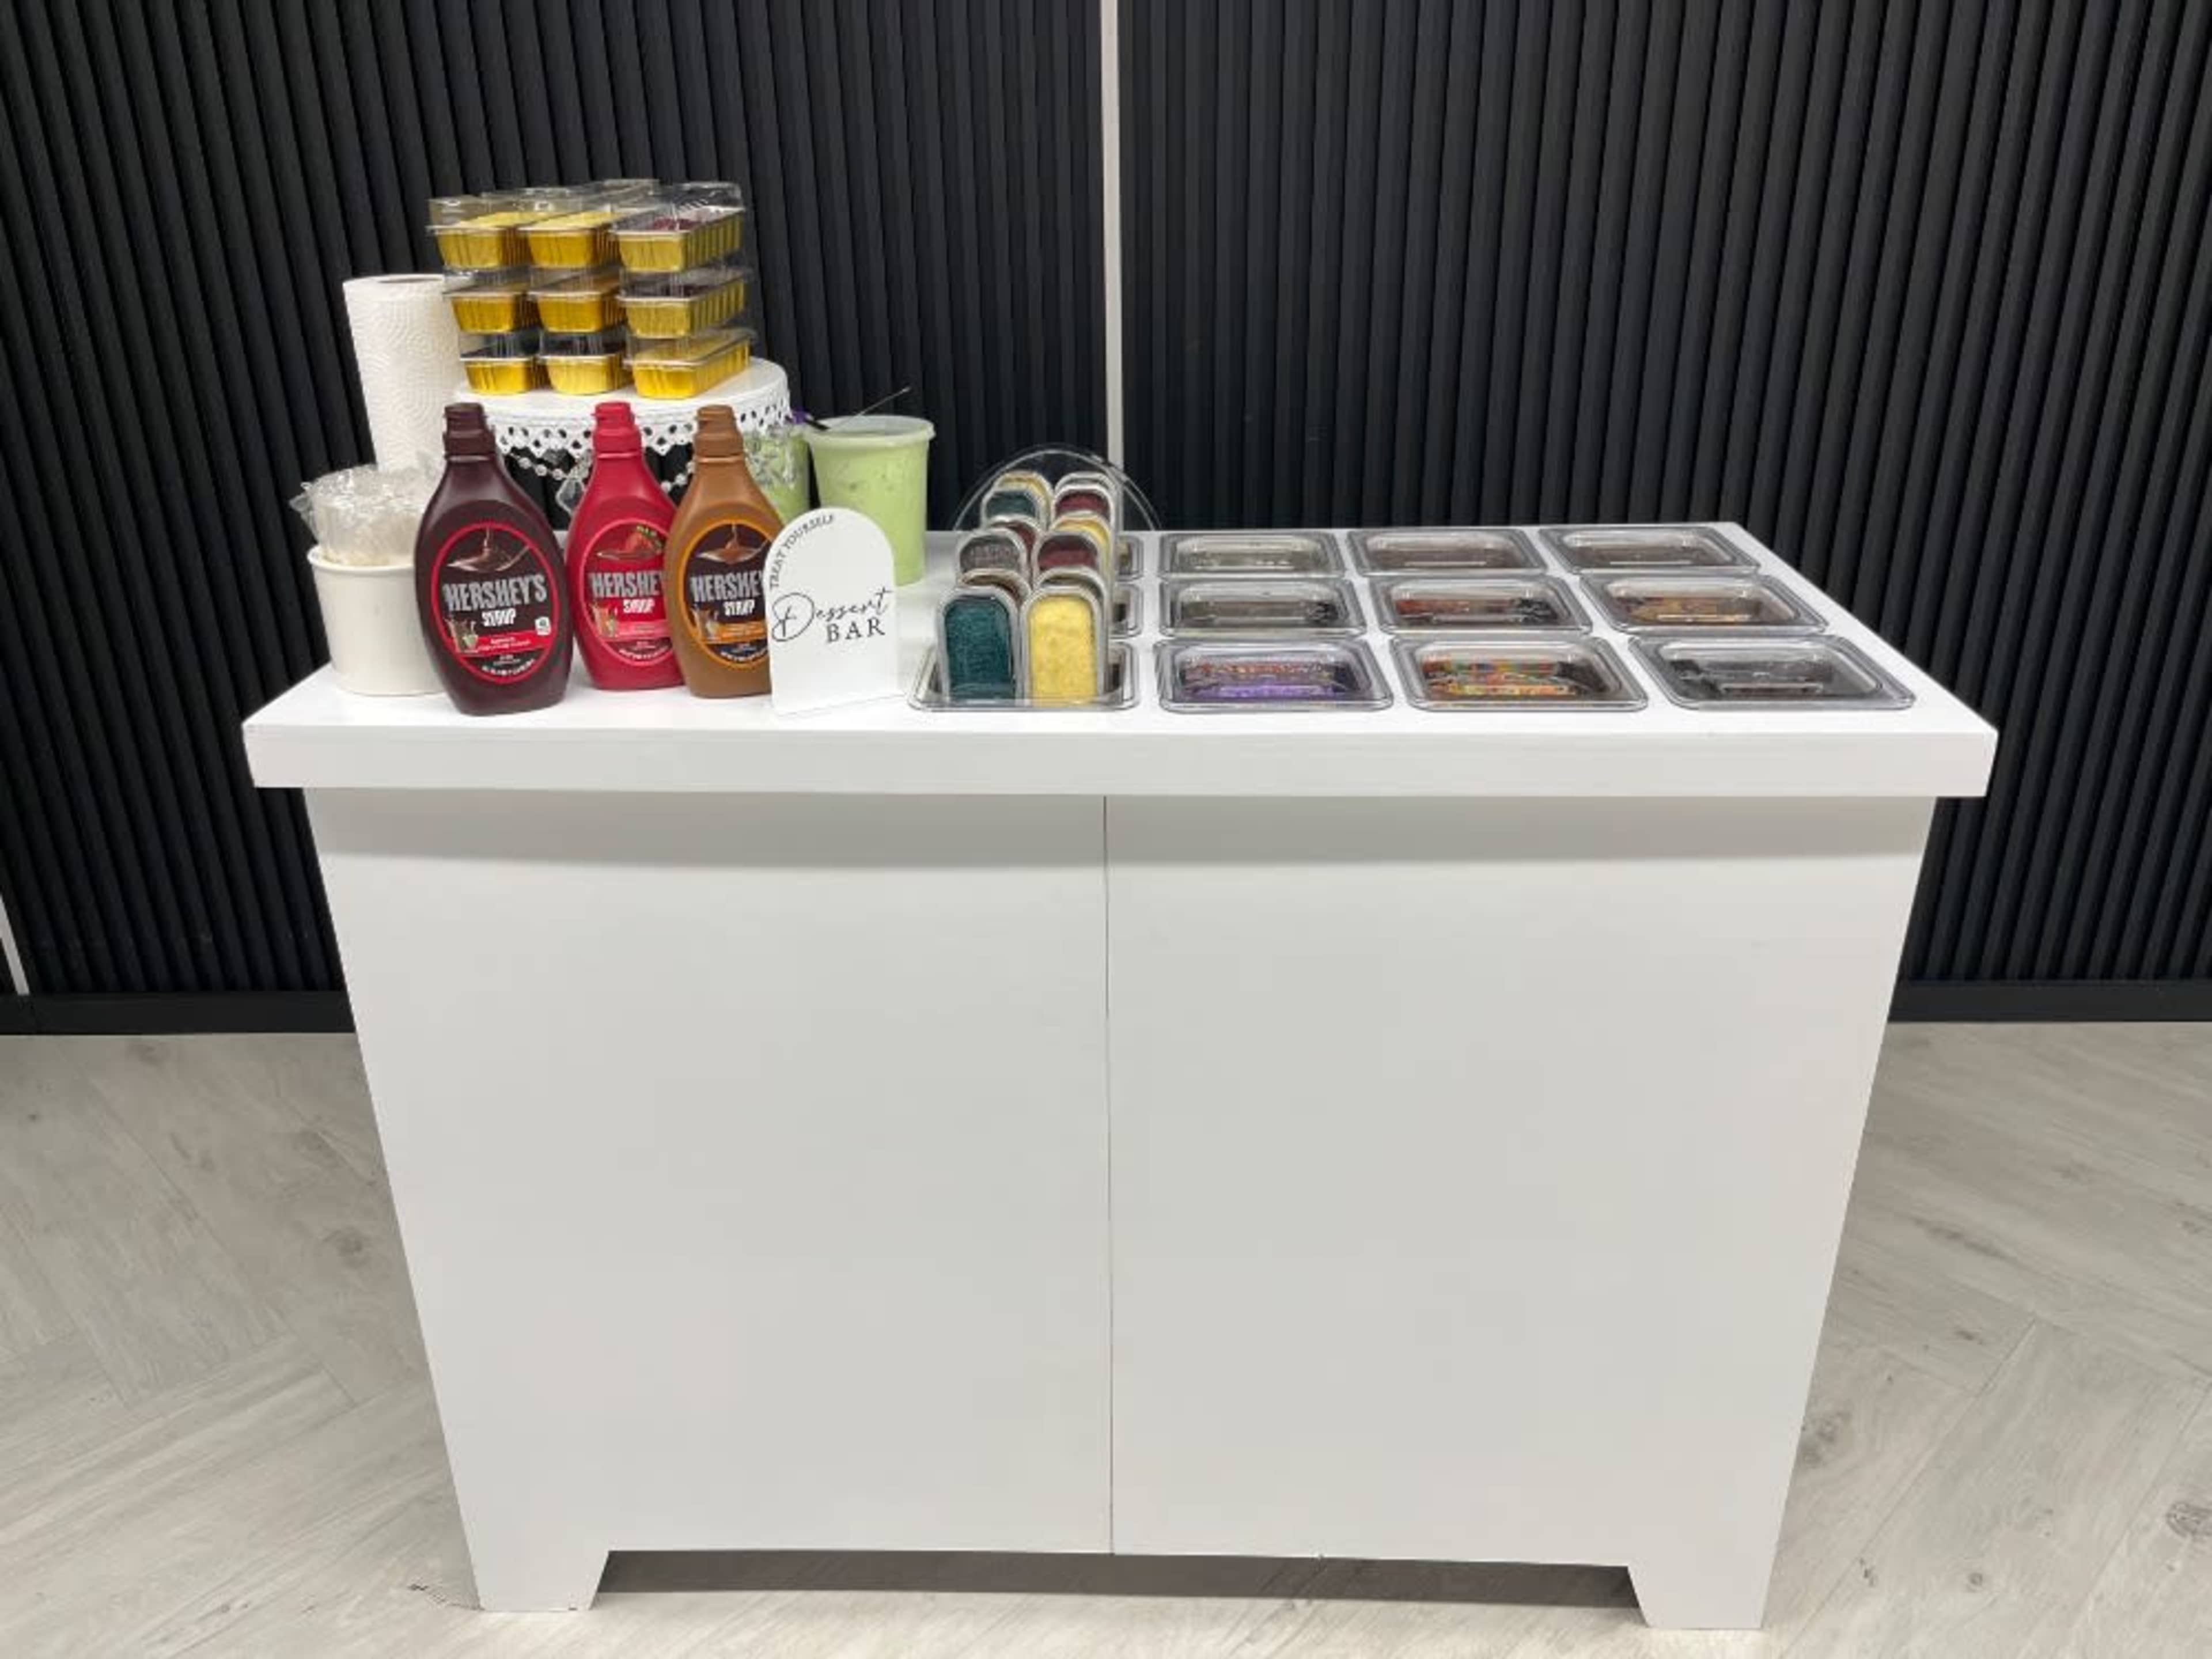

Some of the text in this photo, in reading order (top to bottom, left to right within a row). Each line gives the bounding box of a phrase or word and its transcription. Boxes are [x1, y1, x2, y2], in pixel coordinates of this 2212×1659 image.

[770, 514, 834, 591] TREAT YOURSELF
[442, 574, 547, 612] HERSHEY'S
[588, 570, 664, 597] HERSHE
[691, 570, 763, 601] HERSHE
[771, 587, 893, 643] Dessert
[826, 616, 885, 644] BAR
